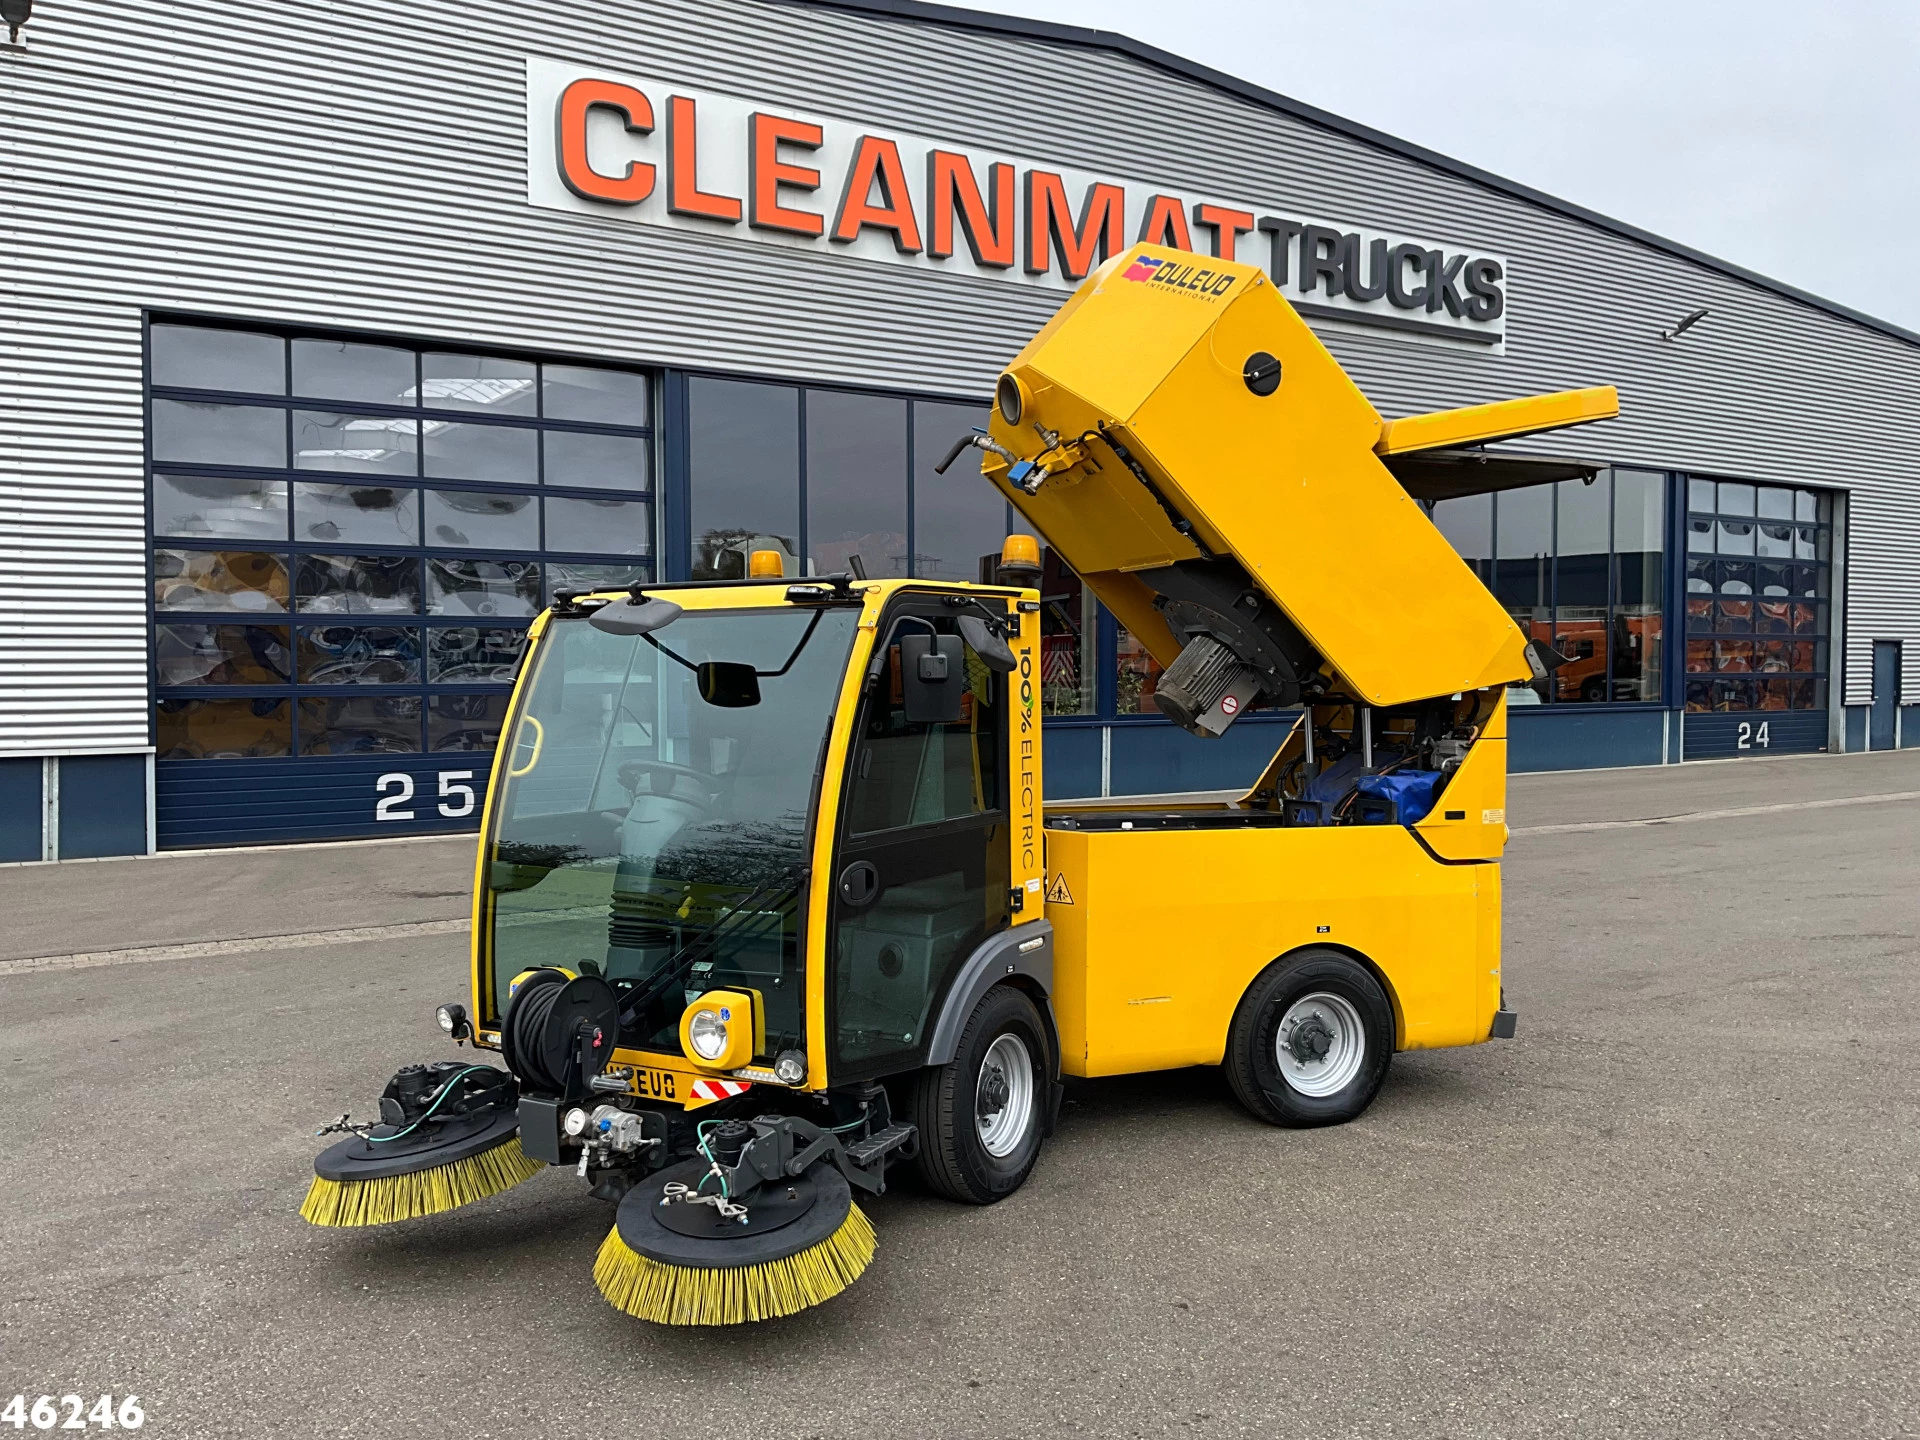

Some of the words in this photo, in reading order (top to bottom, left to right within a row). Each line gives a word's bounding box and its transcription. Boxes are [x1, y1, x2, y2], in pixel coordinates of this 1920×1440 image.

[555, 78, 1254, 281] CLEANMAT
[1258, 216, 1505, 321] TRUCKS
[1145, 282, 1217, 304] INTERNATIONAL
[1152, 262, 1236, 296] DULEVO
[1020, 646, 1033, 734] 100%
[1738, 721, 1770, 749] 24
[1020, 739, 1034, 870] ELECTRIC
